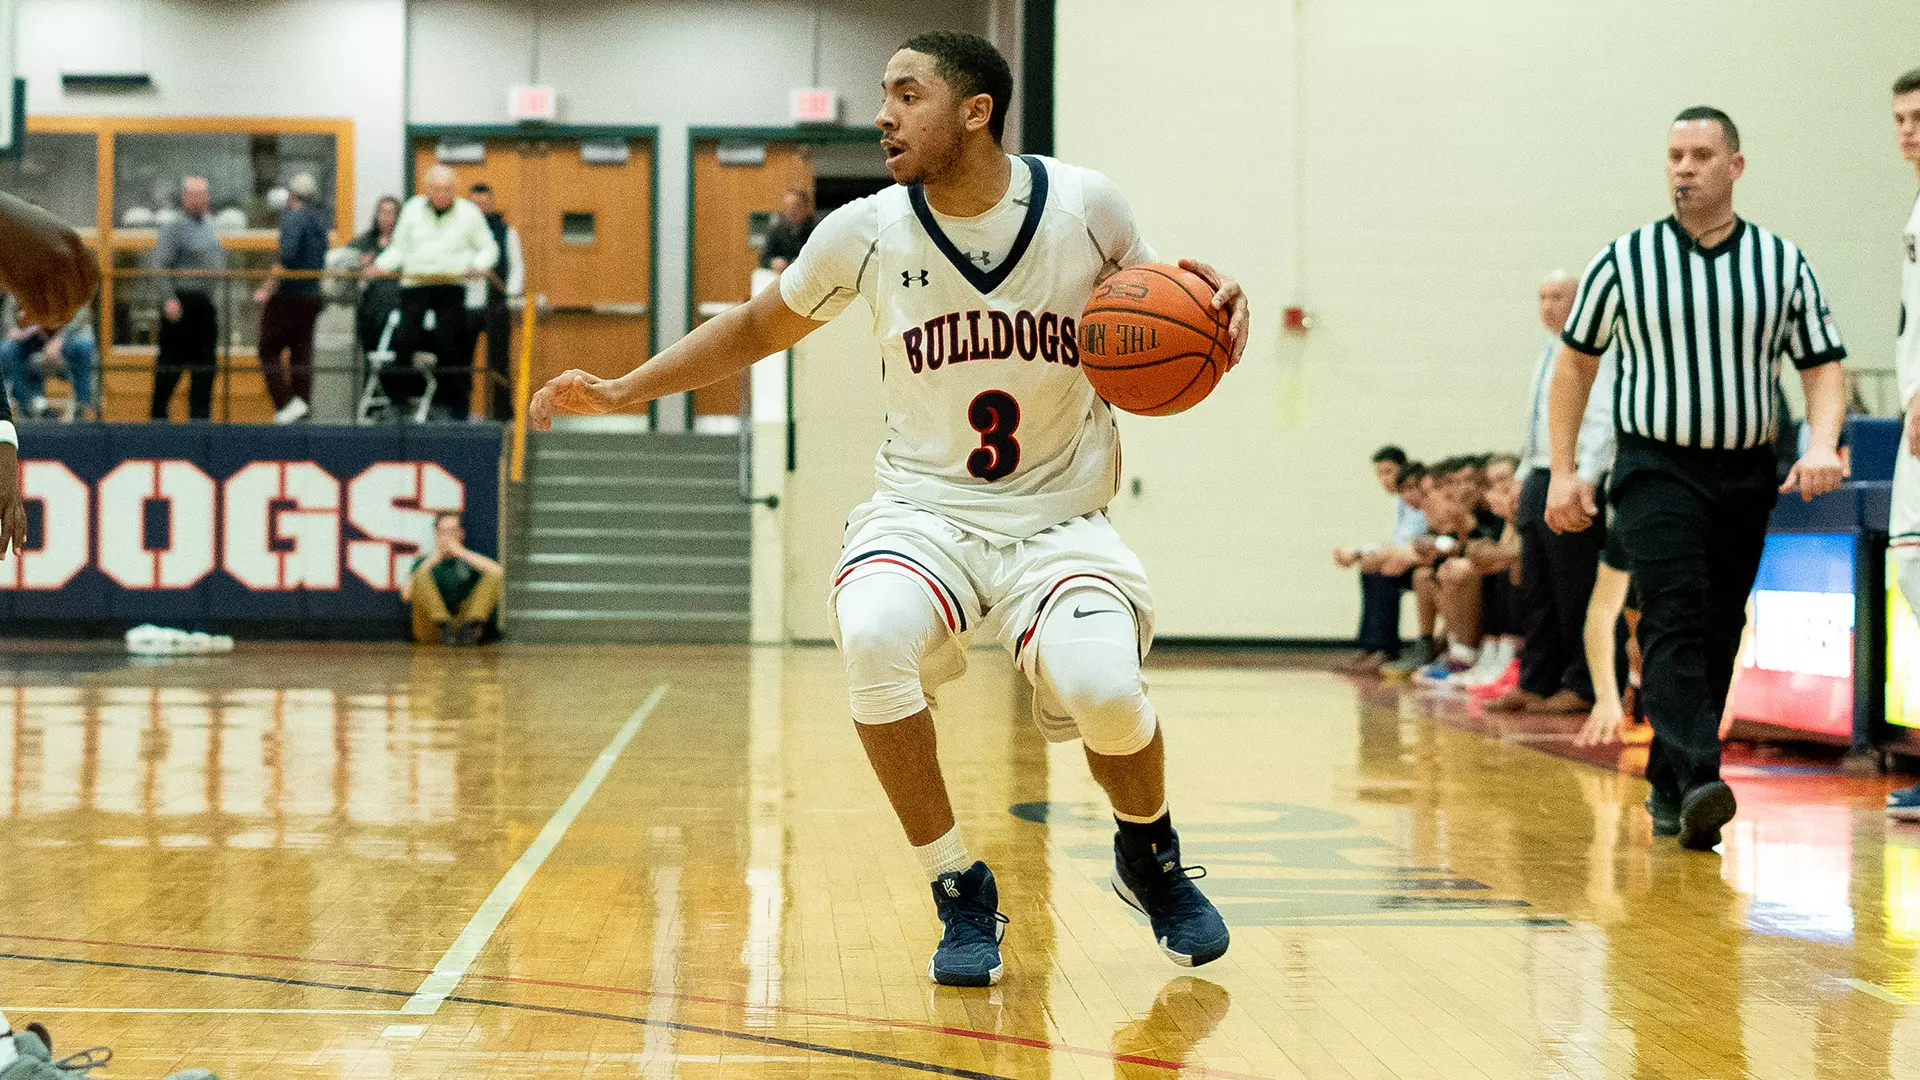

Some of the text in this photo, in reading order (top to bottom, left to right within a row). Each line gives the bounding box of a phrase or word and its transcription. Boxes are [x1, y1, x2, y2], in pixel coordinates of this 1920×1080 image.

[902, 309, 1080, 374] BULLDOGS
[1116, 323, 1160, 356] THE
[966, 389, 1021, 482] 3
[0, 459, 466, 591] DOGS
